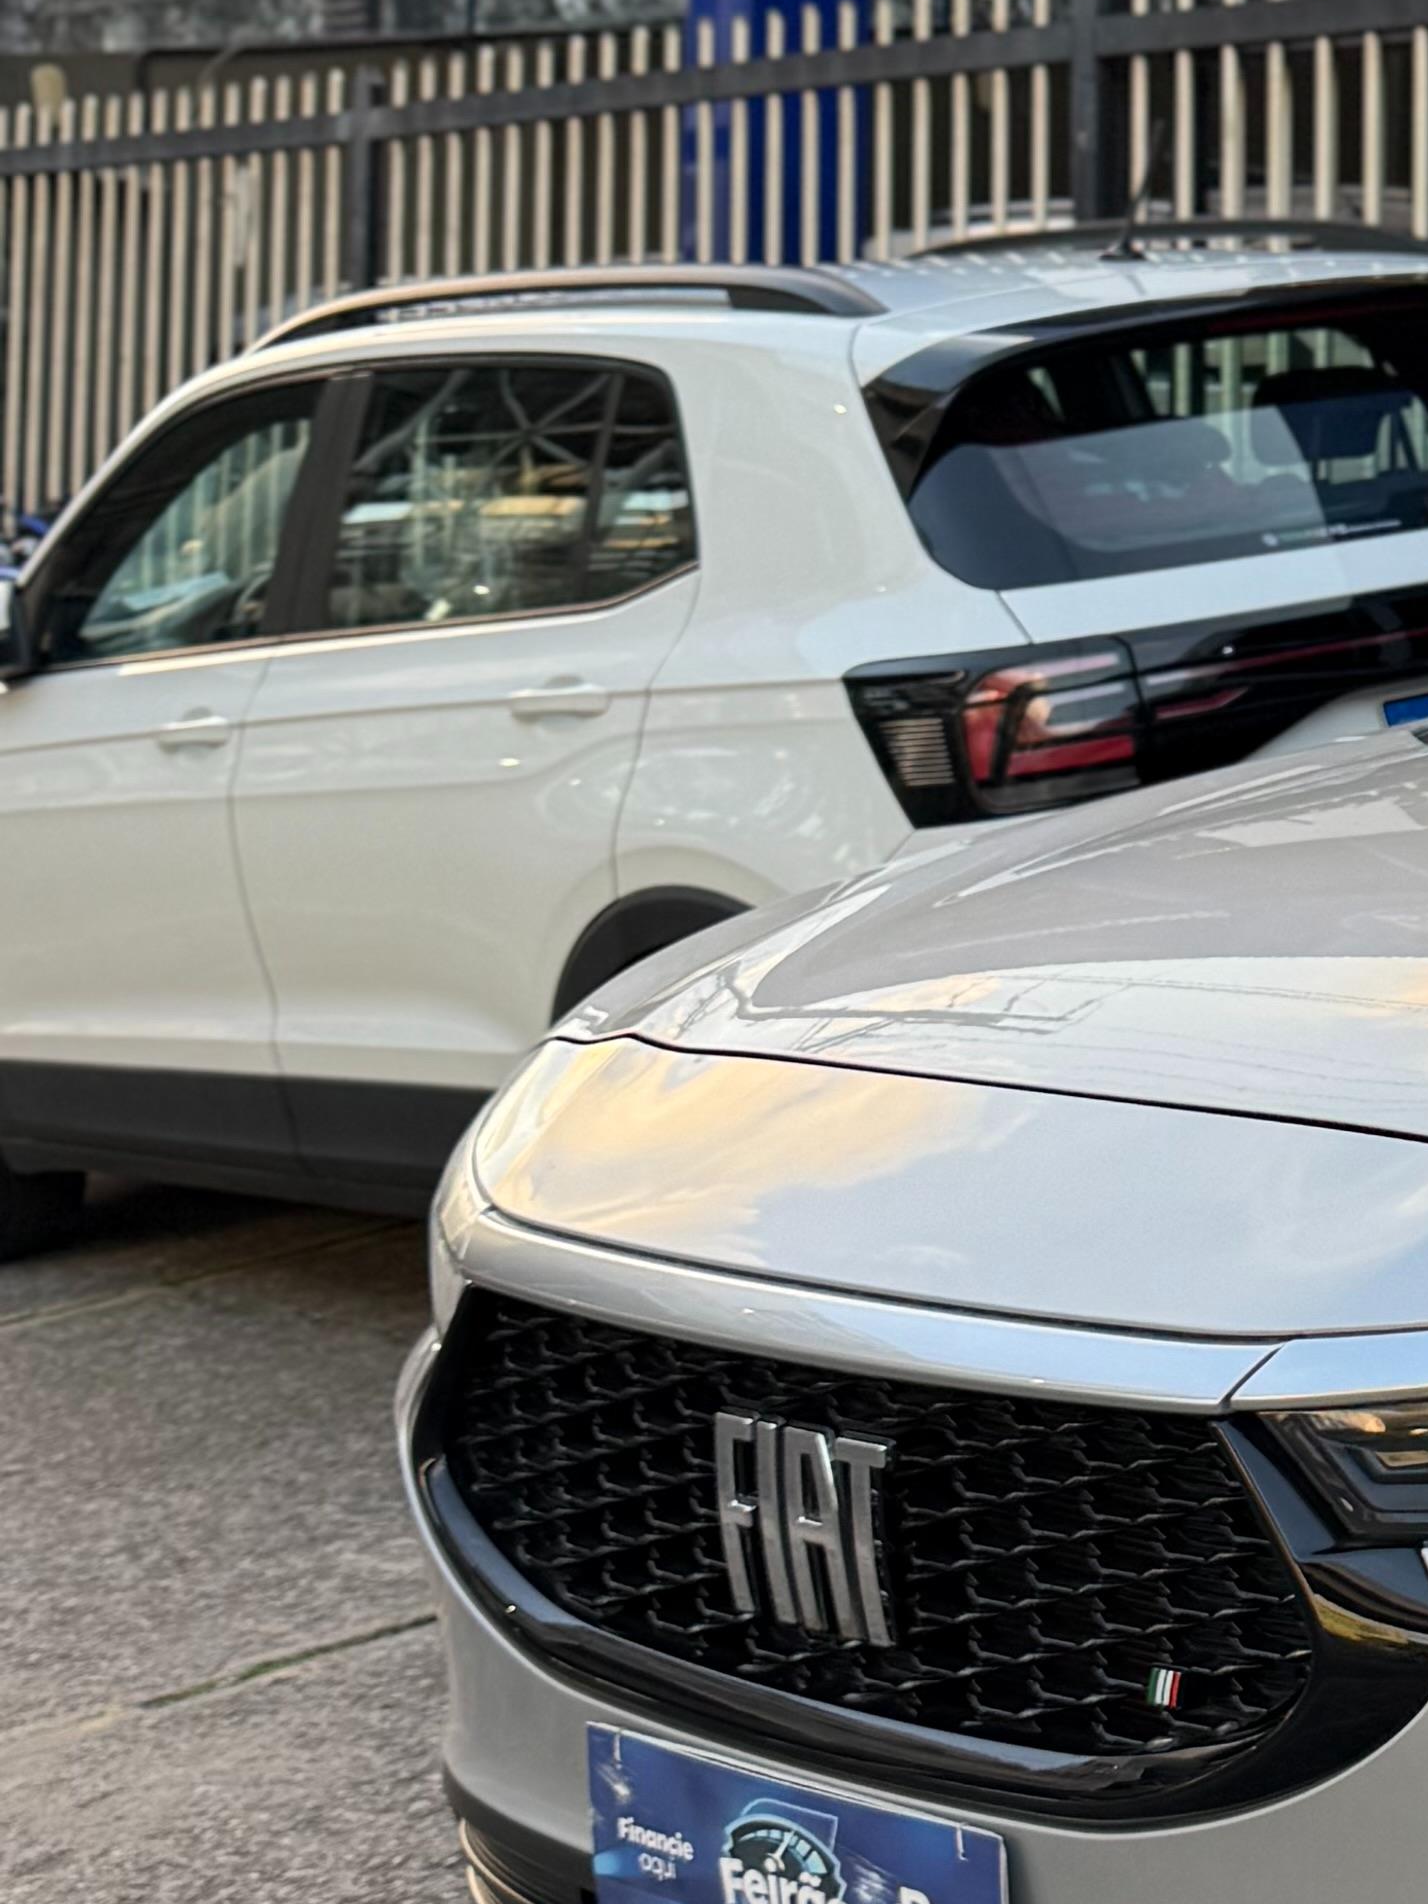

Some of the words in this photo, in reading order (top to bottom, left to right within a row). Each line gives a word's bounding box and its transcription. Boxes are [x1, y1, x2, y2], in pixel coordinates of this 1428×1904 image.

[715, 1410, 896, 1649] FIAT
[616, 1816, 694, 1862] Financie
[639, 1852, 677, 1881] aqui
